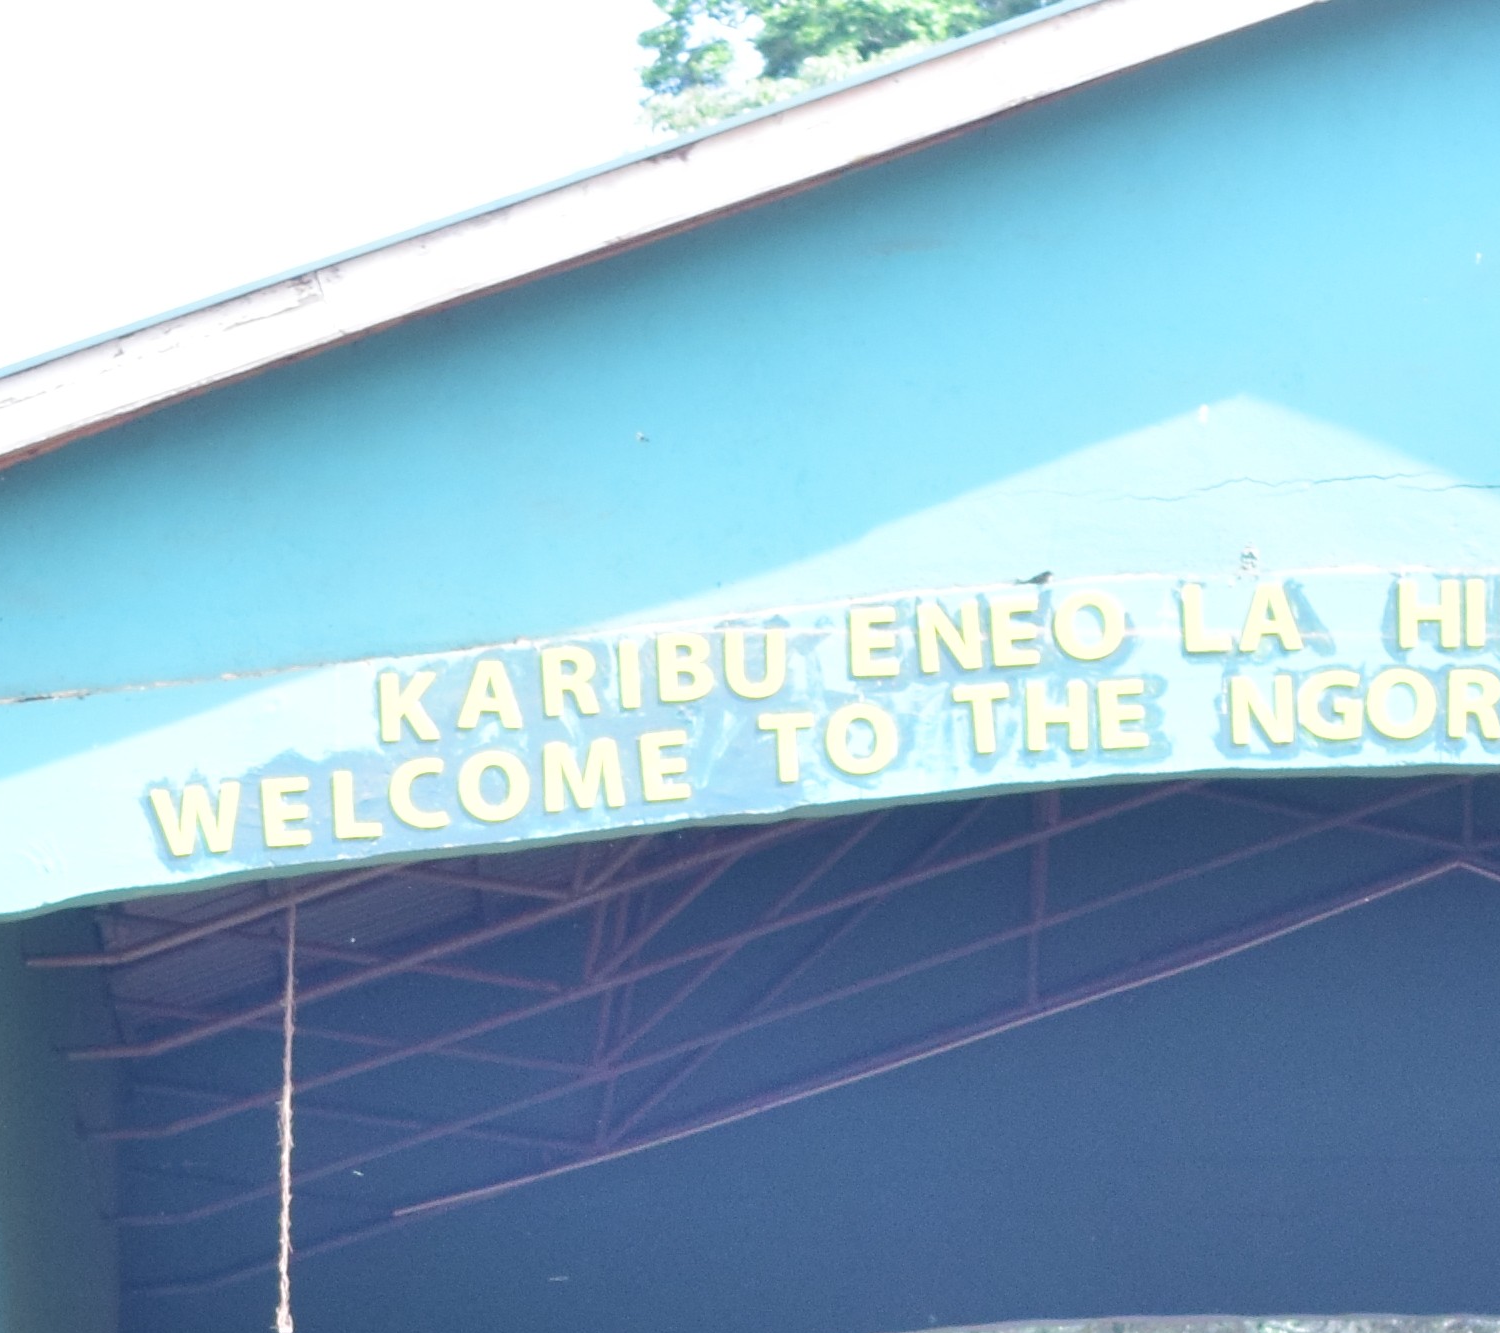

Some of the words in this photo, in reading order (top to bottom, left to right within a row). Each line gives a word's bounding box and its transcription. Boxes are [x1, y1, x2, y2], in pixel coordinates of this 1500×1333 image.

[379, 628, 788, 742] KARIBU
[847, 594, 1126, 680] ENEO
[1180, 580, 1303, 654] LA
[149, 736, 691, 857] WELCOME
[758, 699, 896, 783] TO
[953, 678, 1149, 755] THE
